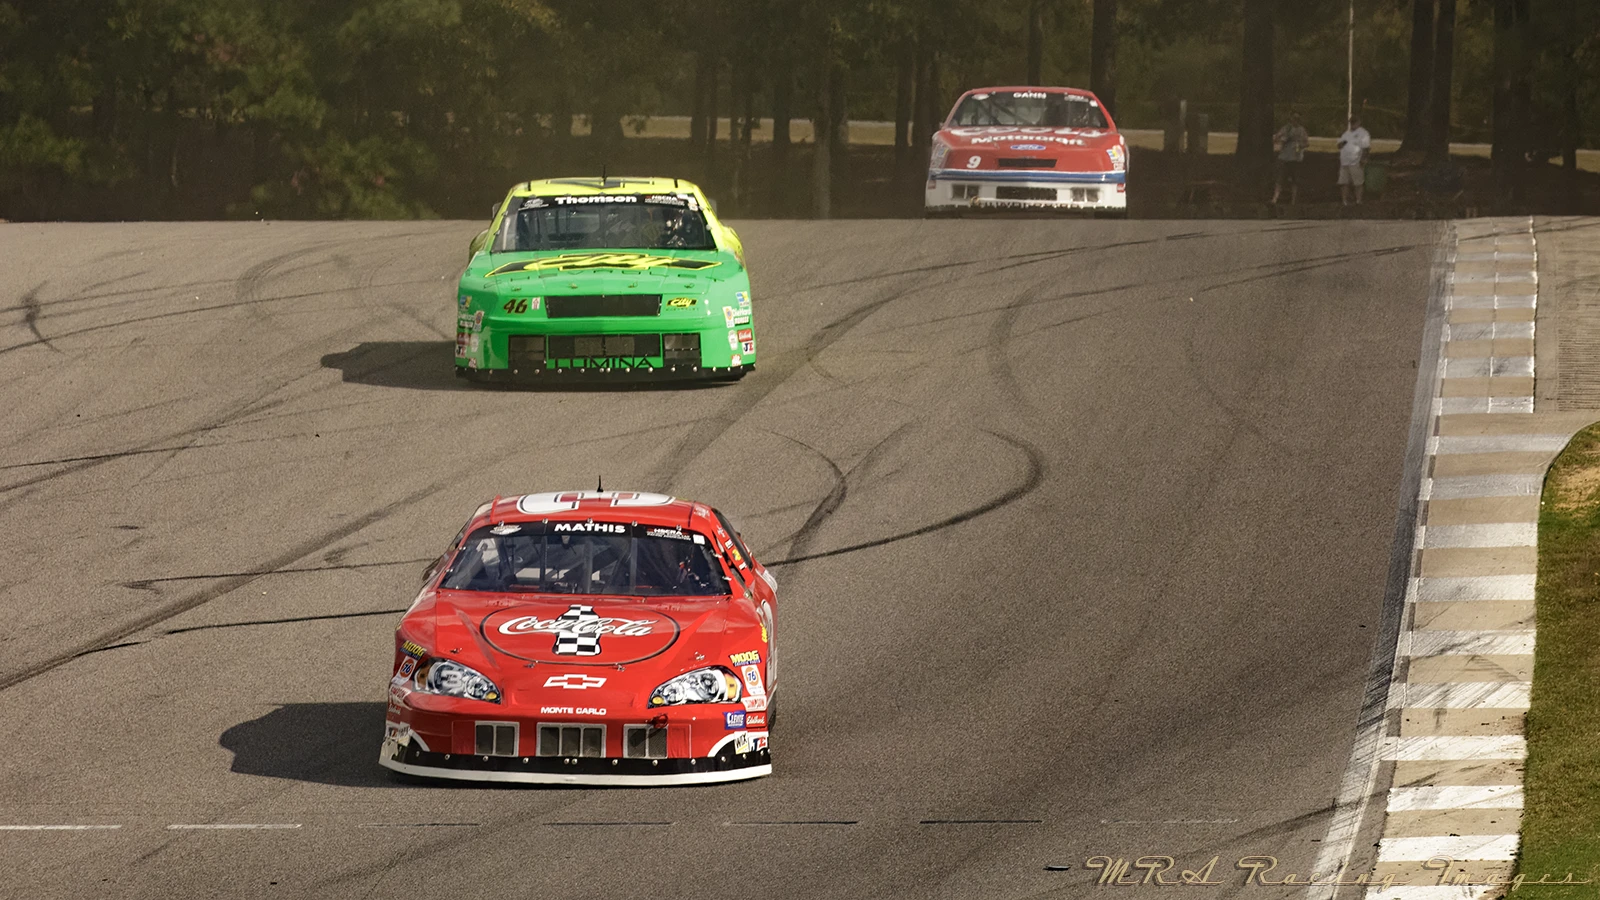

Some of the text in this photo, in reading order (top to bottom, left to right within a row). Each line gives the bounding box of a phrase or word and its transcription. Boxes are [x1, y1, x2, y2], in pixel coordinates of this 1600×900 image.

[971, 134, 1085, 145] Motorcraft
[966, 155, 982, 169] 9
[554, 195, 637, 205] Thomson
[503, 298, 528, 315] 46
[555, 355, 655, 369] LUMINA
[554, 522, 626, 534] MATHIS
[403, 640, 427, 656] MOOG
[730, 650, 760, 663] MOOG
[401, 663, 412, 674] 76
[747, 670, 757, 682] 76
[541, 706, 607, 716] MONTE CARLO
